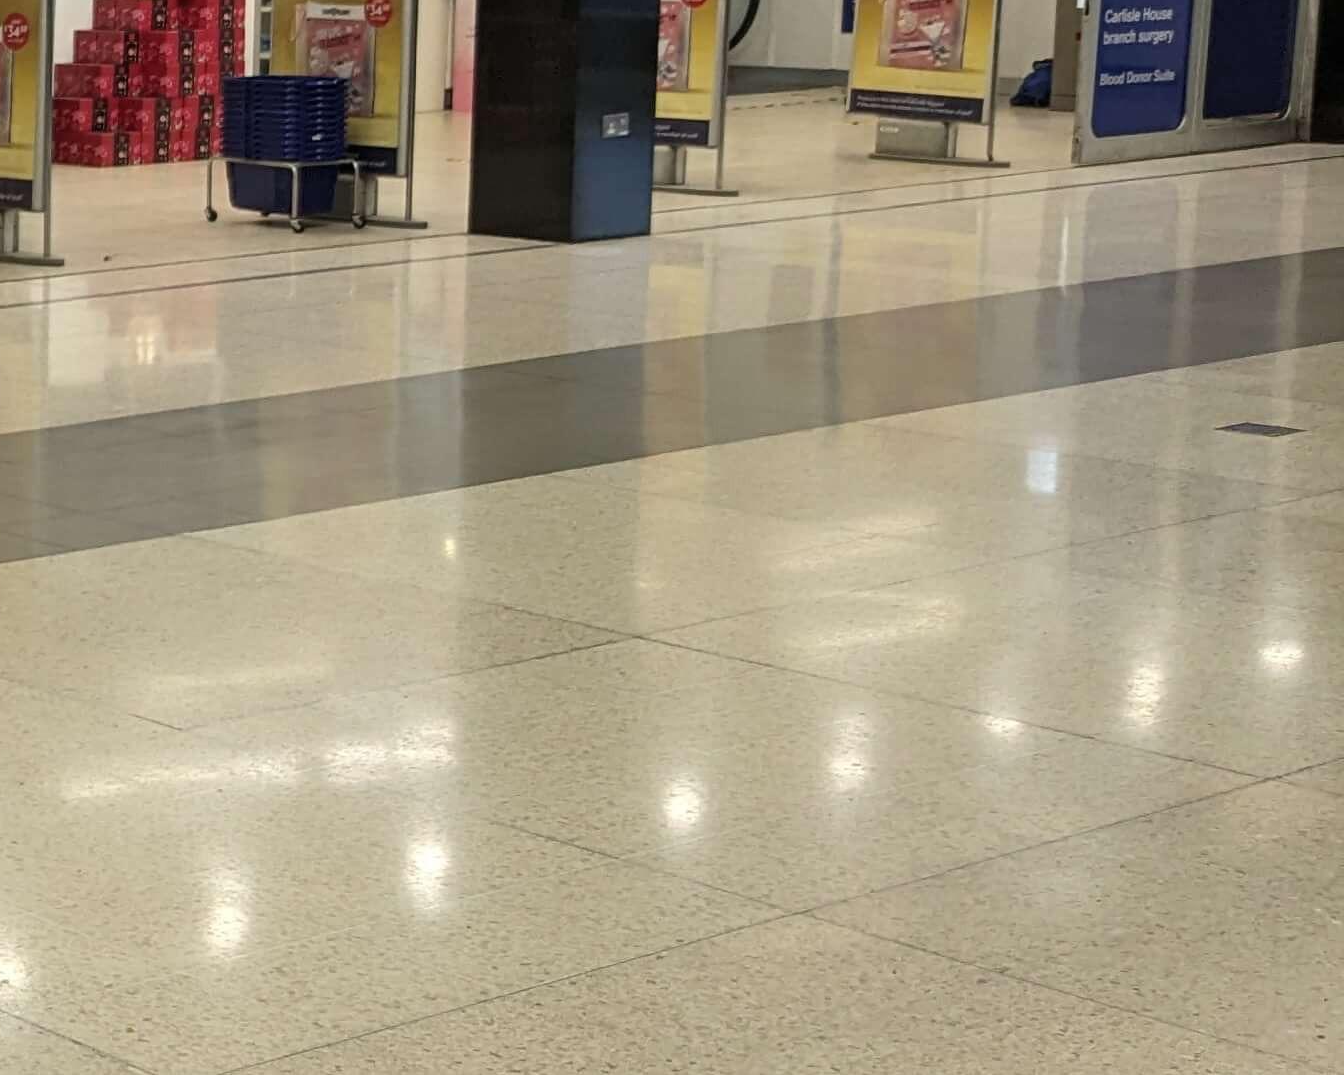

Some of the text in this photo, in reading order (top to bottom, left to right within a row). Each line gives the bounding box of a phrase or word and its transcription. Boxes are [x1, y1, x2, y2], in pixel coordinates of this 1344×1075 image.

[1104, 7, 1174, 24] Carlisle House
[1103, 30, 1174, 45] branch surgery
[1099, 69, 1176, 86] Blood Donor Suite
